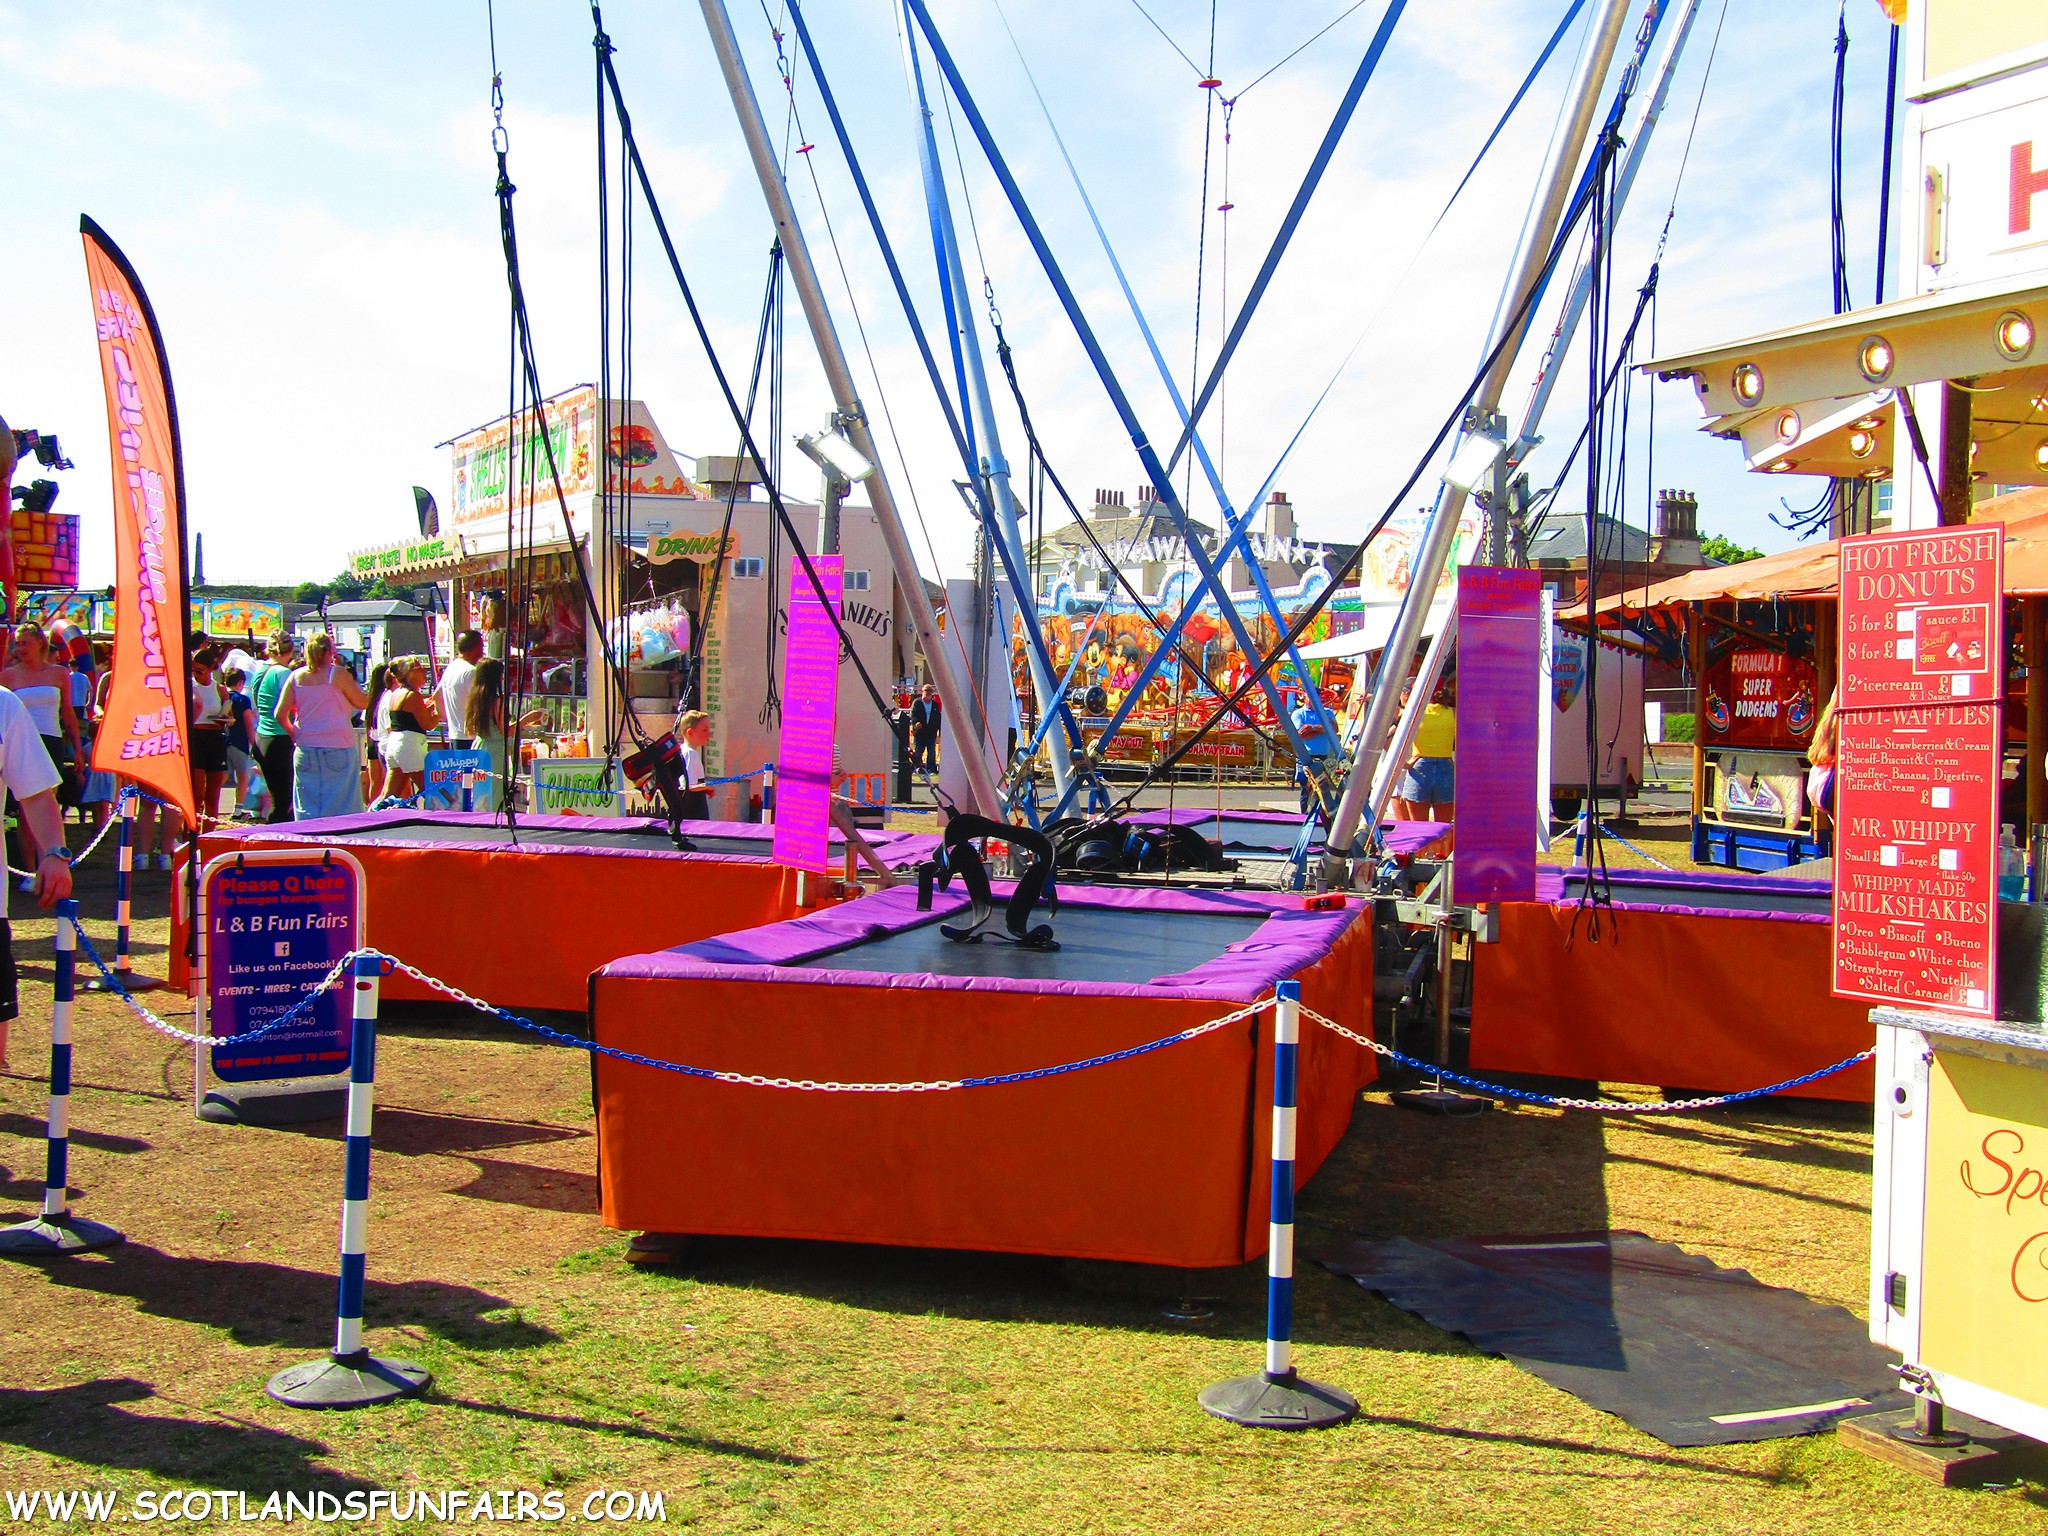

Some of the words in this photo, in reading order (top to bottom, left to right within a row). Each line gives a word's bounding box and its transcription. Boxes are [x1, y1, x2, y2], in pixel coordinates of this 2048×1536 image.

[406, 546, 418, 564] NO
[654, 536, 734, 556] DRINKS
[1844, 545, 1899, 572] HOT
[1905, 536, 1994, 567] FRESH
[1492, 576, 1511, 589] Fun
[1514, 577, 1538, 590] Fairs
[1858, 567, 1975, 601] DONUTS
[840, 600, 892, 637] ANIEL'S
[1849, 614, 1857, 632] 5
[1862, 615, 1880, 632] for
[1926, 616, 1958, 626] sauce
[1848, 643, 1856, 660] 8
[1861, 644, 1880, 660] for
[1732, 654, 1774, 672] FORMULA
[1742, 678, 1772, 696] SUPER
[1910, 691, 1917, 700] &
[1928, 690, 1952, 700] Sauce
[1735, 700, 1778, 718] DODGEMS
[1128, 736, 1144, 748] OUT
[1220, 745, 1244, 758] TRAIN
[1934, 768, 1983, 783] Digestive,
[1850, 817, 1886, 838] MR.
[1892, 819, 1976, 843] WHIPPY
[1844, 848, 1870, 862] Small
[1900, 852, 1928, 868] Large
[220, 878, 280, 893] Please
[284, 876, 300, 893] Q
[304, 876, 346, 890] here
[1852, 874, 1914, 893] WHIPPY
[1917, 880, 1966, 898] MADE
[1962, 872, 1976, 884] 50p
[1839, 890, 1987, 924] MILKSHAKES
[216, 918, 226, 933] L
[230, 917, 244, 932] &
[250, 916, 262, 932] B
[268, 916, 300, 931] Fun
[306, 912, 348, 930] Fairs
[1846, 920, 1874, 938] Oreo
[1886, 925, 1926, 944] Biscoff
[1943, 930, 1981, 950] Bueno
[1846, 939, 1906, 961] Bubblegum
[1916, 947, 1953, 966] White
[1956, 953, 1983, 969] choc
[229, 964, 250, 974] Like
[284, 960, 336, 971] Facebook!
[1844, 957, 1904, 981] Strawberry
[1928, 968, 1975, 988] Nutella
[218, 986, 254, 996] EVENTS
[264, 984, 290, 994] HIRES
[1864, 975, 1900, 994] Salted
[1904, 980, 1953, 1001] Caramel
